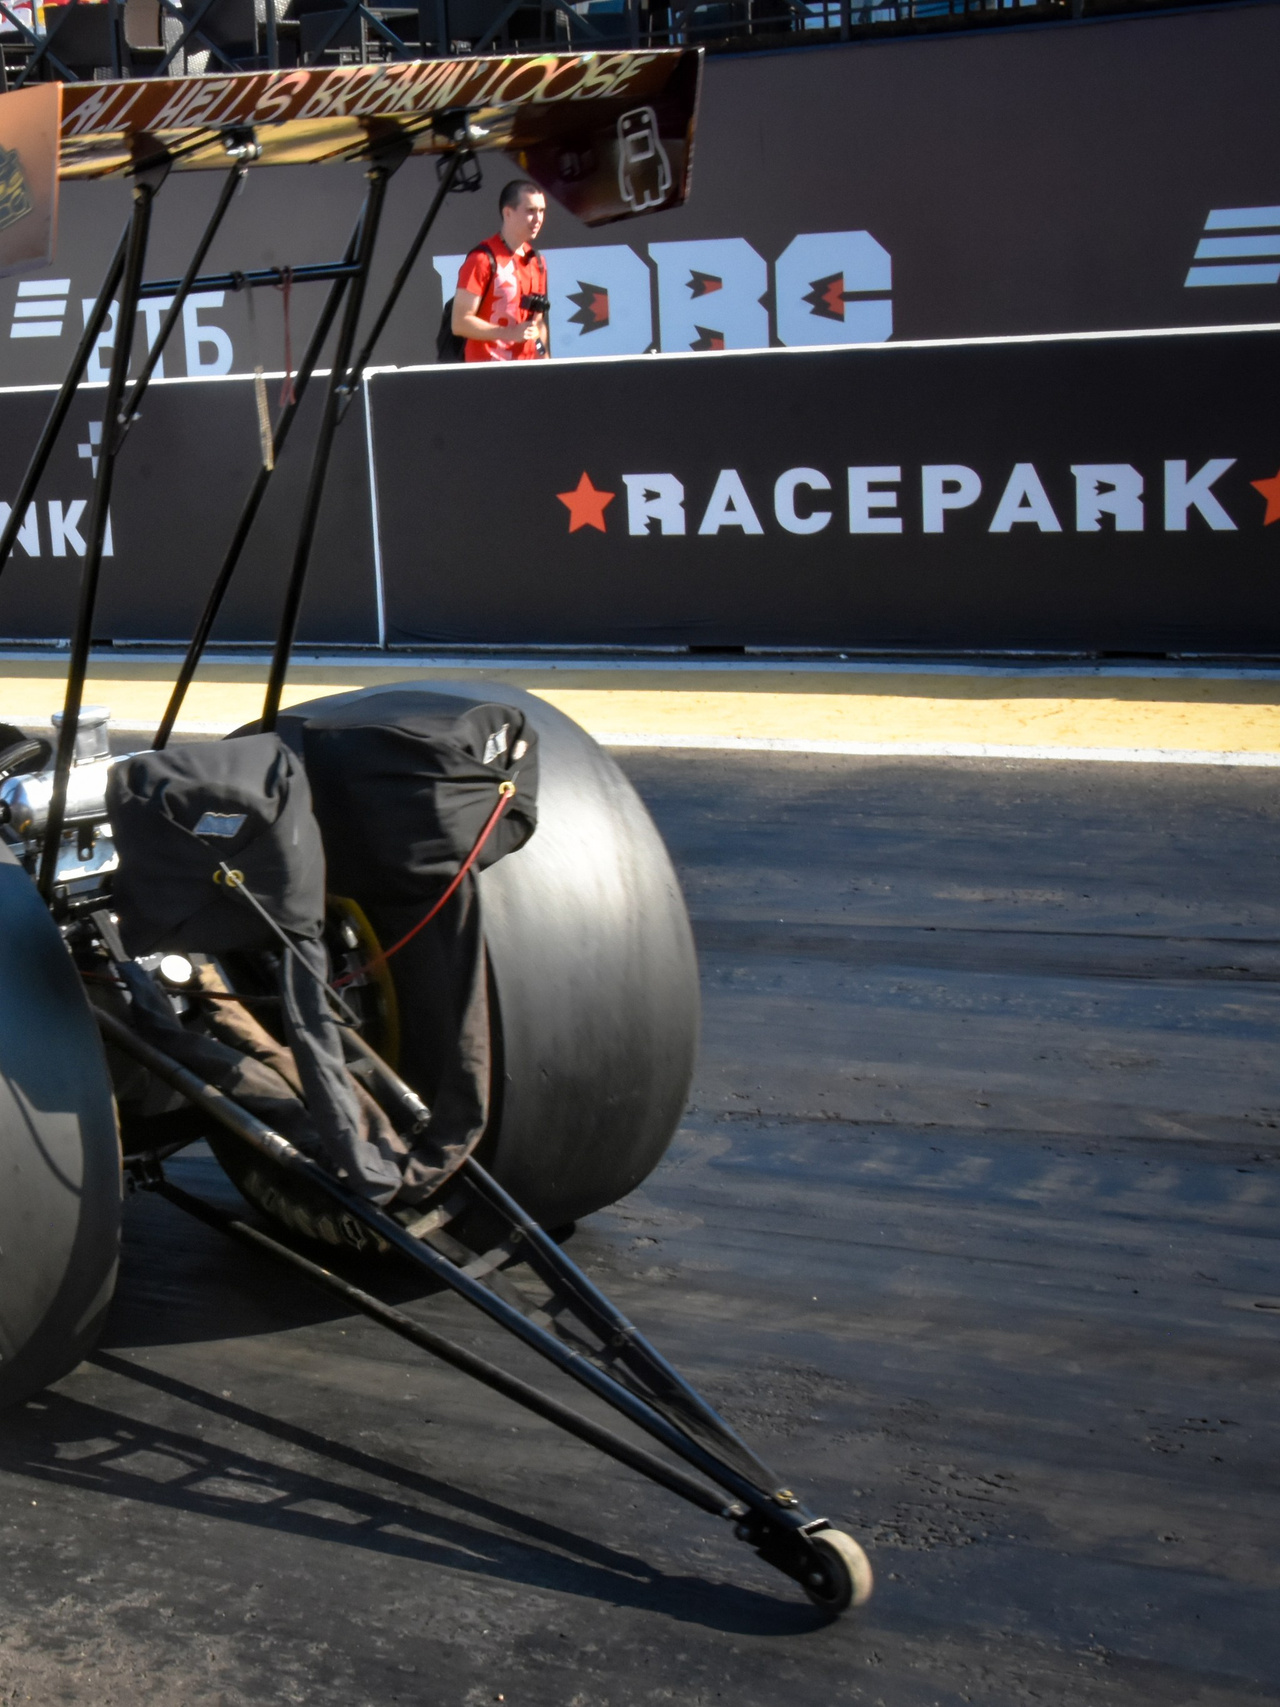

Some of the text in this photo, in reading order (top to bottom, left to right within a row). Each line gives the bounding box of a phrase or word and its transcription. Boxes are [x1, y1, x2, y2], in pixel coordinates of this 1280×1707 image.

[60, 83, 147, 134] ALL
[144, 71, 310, 131] HELL'S
[467, 53, 657, 107] LOOSE
[432, 230, 894, 359] DRC
[622, 458, 1238, 535] RACEPARK
